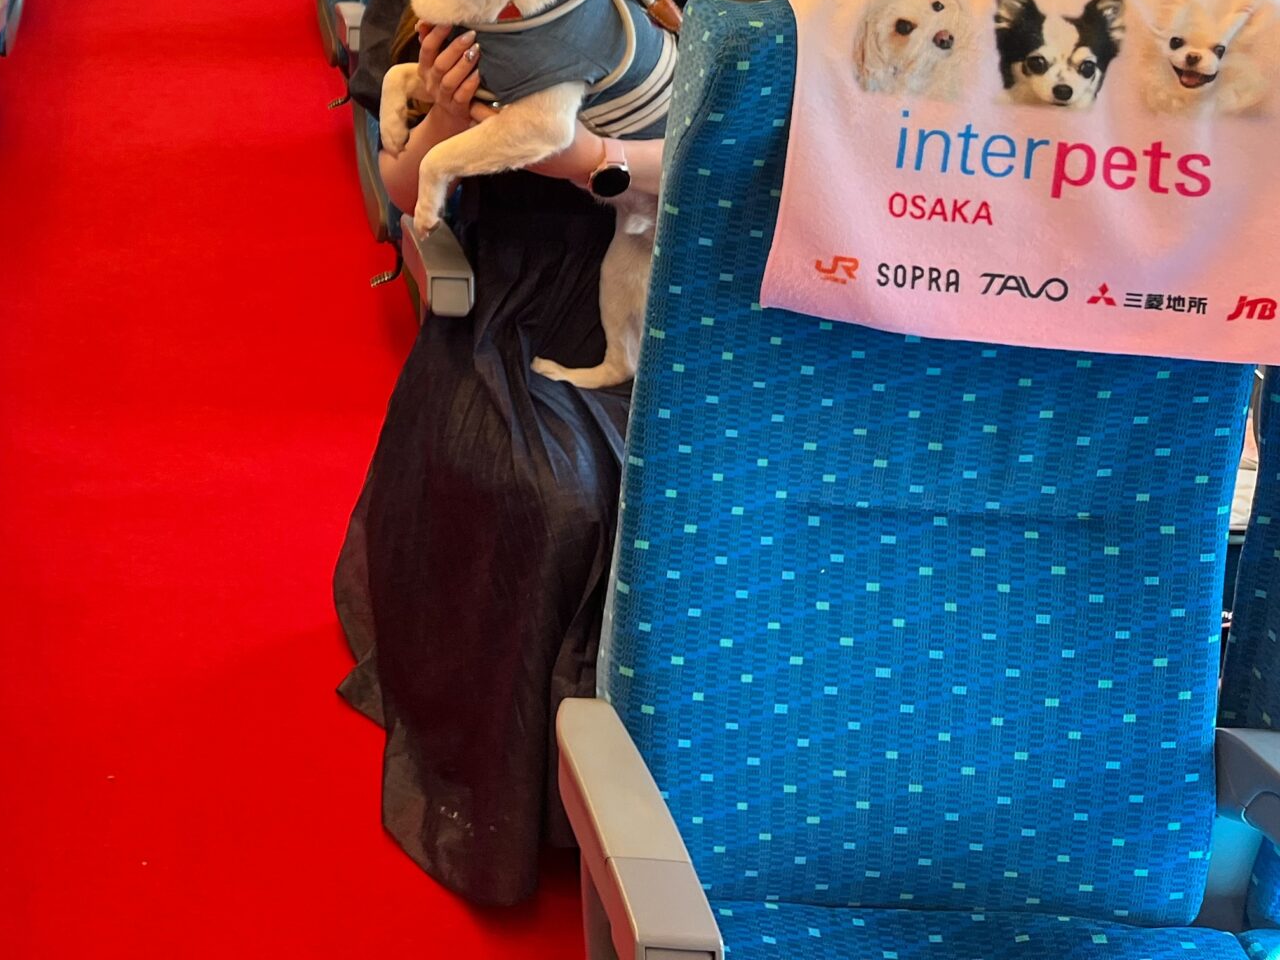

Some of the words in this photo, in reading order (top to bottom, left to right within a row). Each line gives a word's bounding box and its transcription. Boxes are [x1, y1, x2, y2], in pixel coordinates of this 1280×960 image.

[895, 110, 1212, 199] interpets
[888, 191, 993, 226] OSAKA
[815, 255, 859, 280] JR
[876, 262, 960, 293] SOPRA
[979, 272, 1069, 302] TAVO
[1123, 292, 1208, 315] 三菱地所
[1226, 295, 1278, 322] JTB
